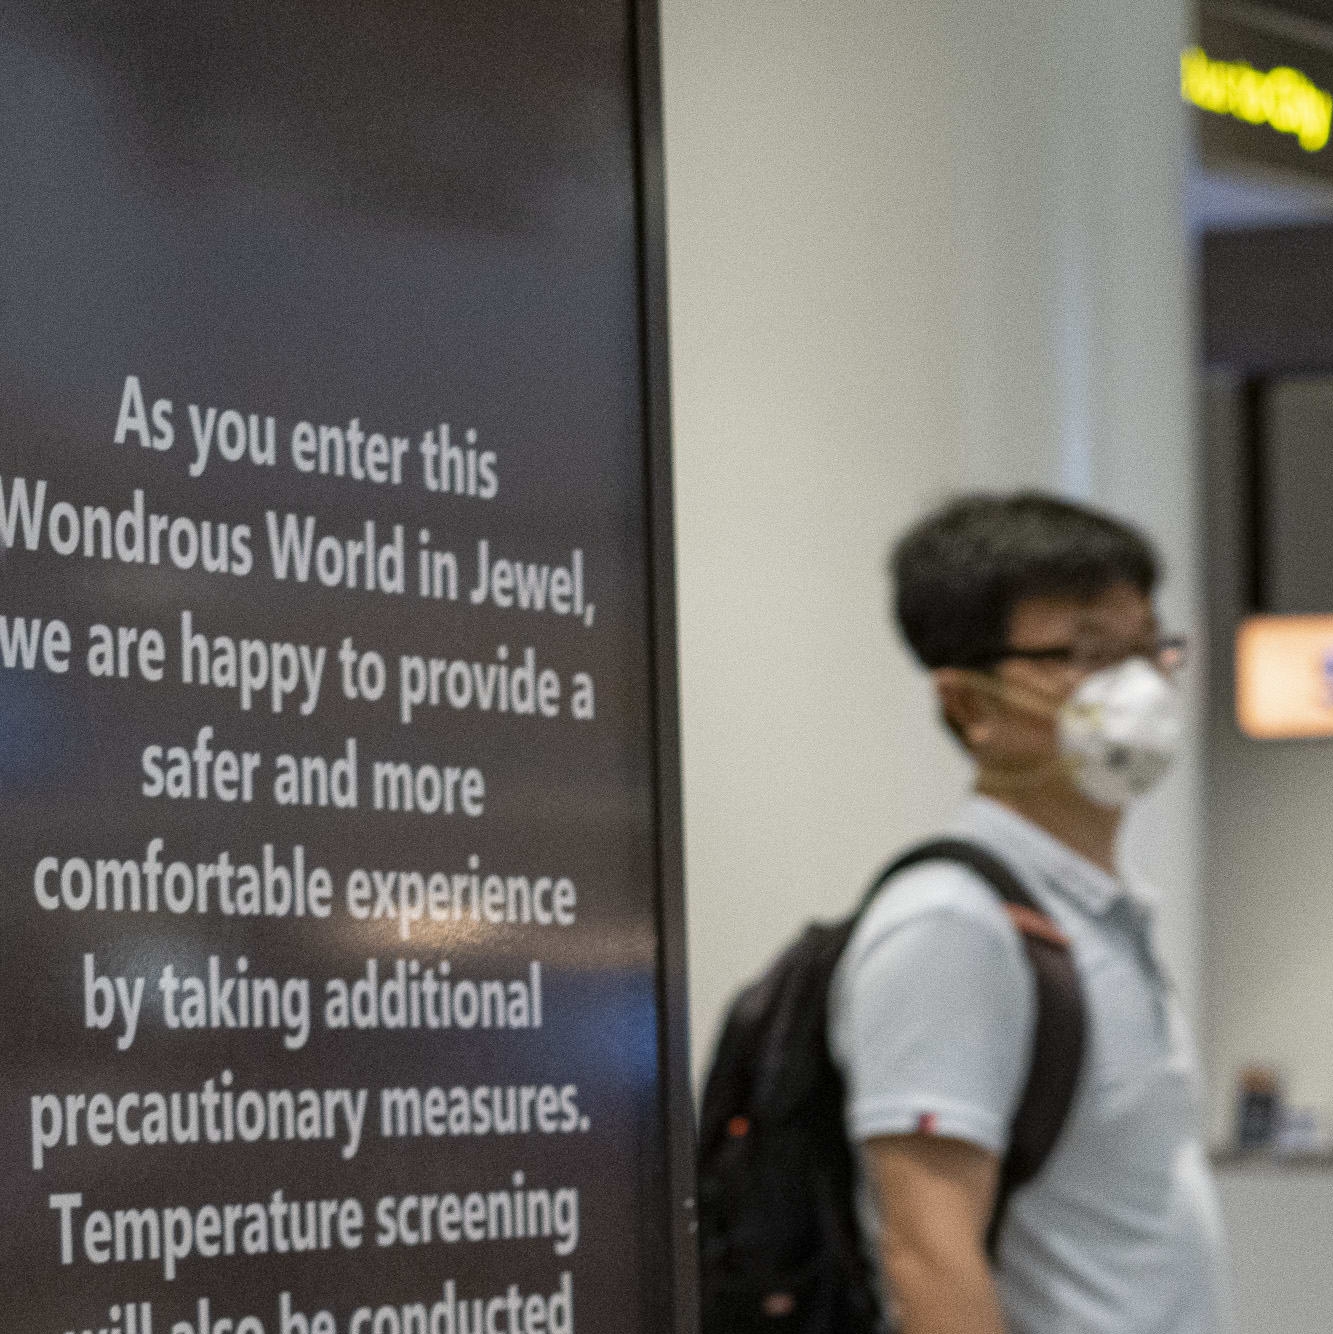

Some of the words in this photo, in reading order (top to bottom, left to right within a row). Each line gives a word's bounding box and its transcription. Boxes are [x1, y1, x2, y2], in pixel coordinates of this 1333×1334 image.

[114, 375, 174, 451] As
[188, 404, 276, 477] you
[291, 418, 409, 484] enter
[419, 423, 498, 499] this
[0, 474, 253, 576] Wondrous
[266, 511, 405, 594] World
[419, 529, 458, 600] in
[470, 540, 595, 626] Jewel,
[0, 615, 71, 673] we
[87, 624, 165, 682] are
[181, 610, 326, 715] happy
[338, 638, 386, 701] to
[400, 645, 560, 724] provide
[571, 672, 595, 719] a
[142, 726, 261, 802] safer
[274, 738, 358, 808] and
[373, 762, 485, 816] more
[34, 838, 333, 918] comfortable
[346, 855, 576, 938] experience
[83, 953, 145, 1050] by
[159, 955, 310, 1049] taking
[325, 958, 542, 1029] additional
[30, 1070, 368, 1170] precautionary
[381, 1084, 591, 1136] measures.
[48, 1191, 364, 1280] Temperature
[376, 1171, 579, 1255] screening
